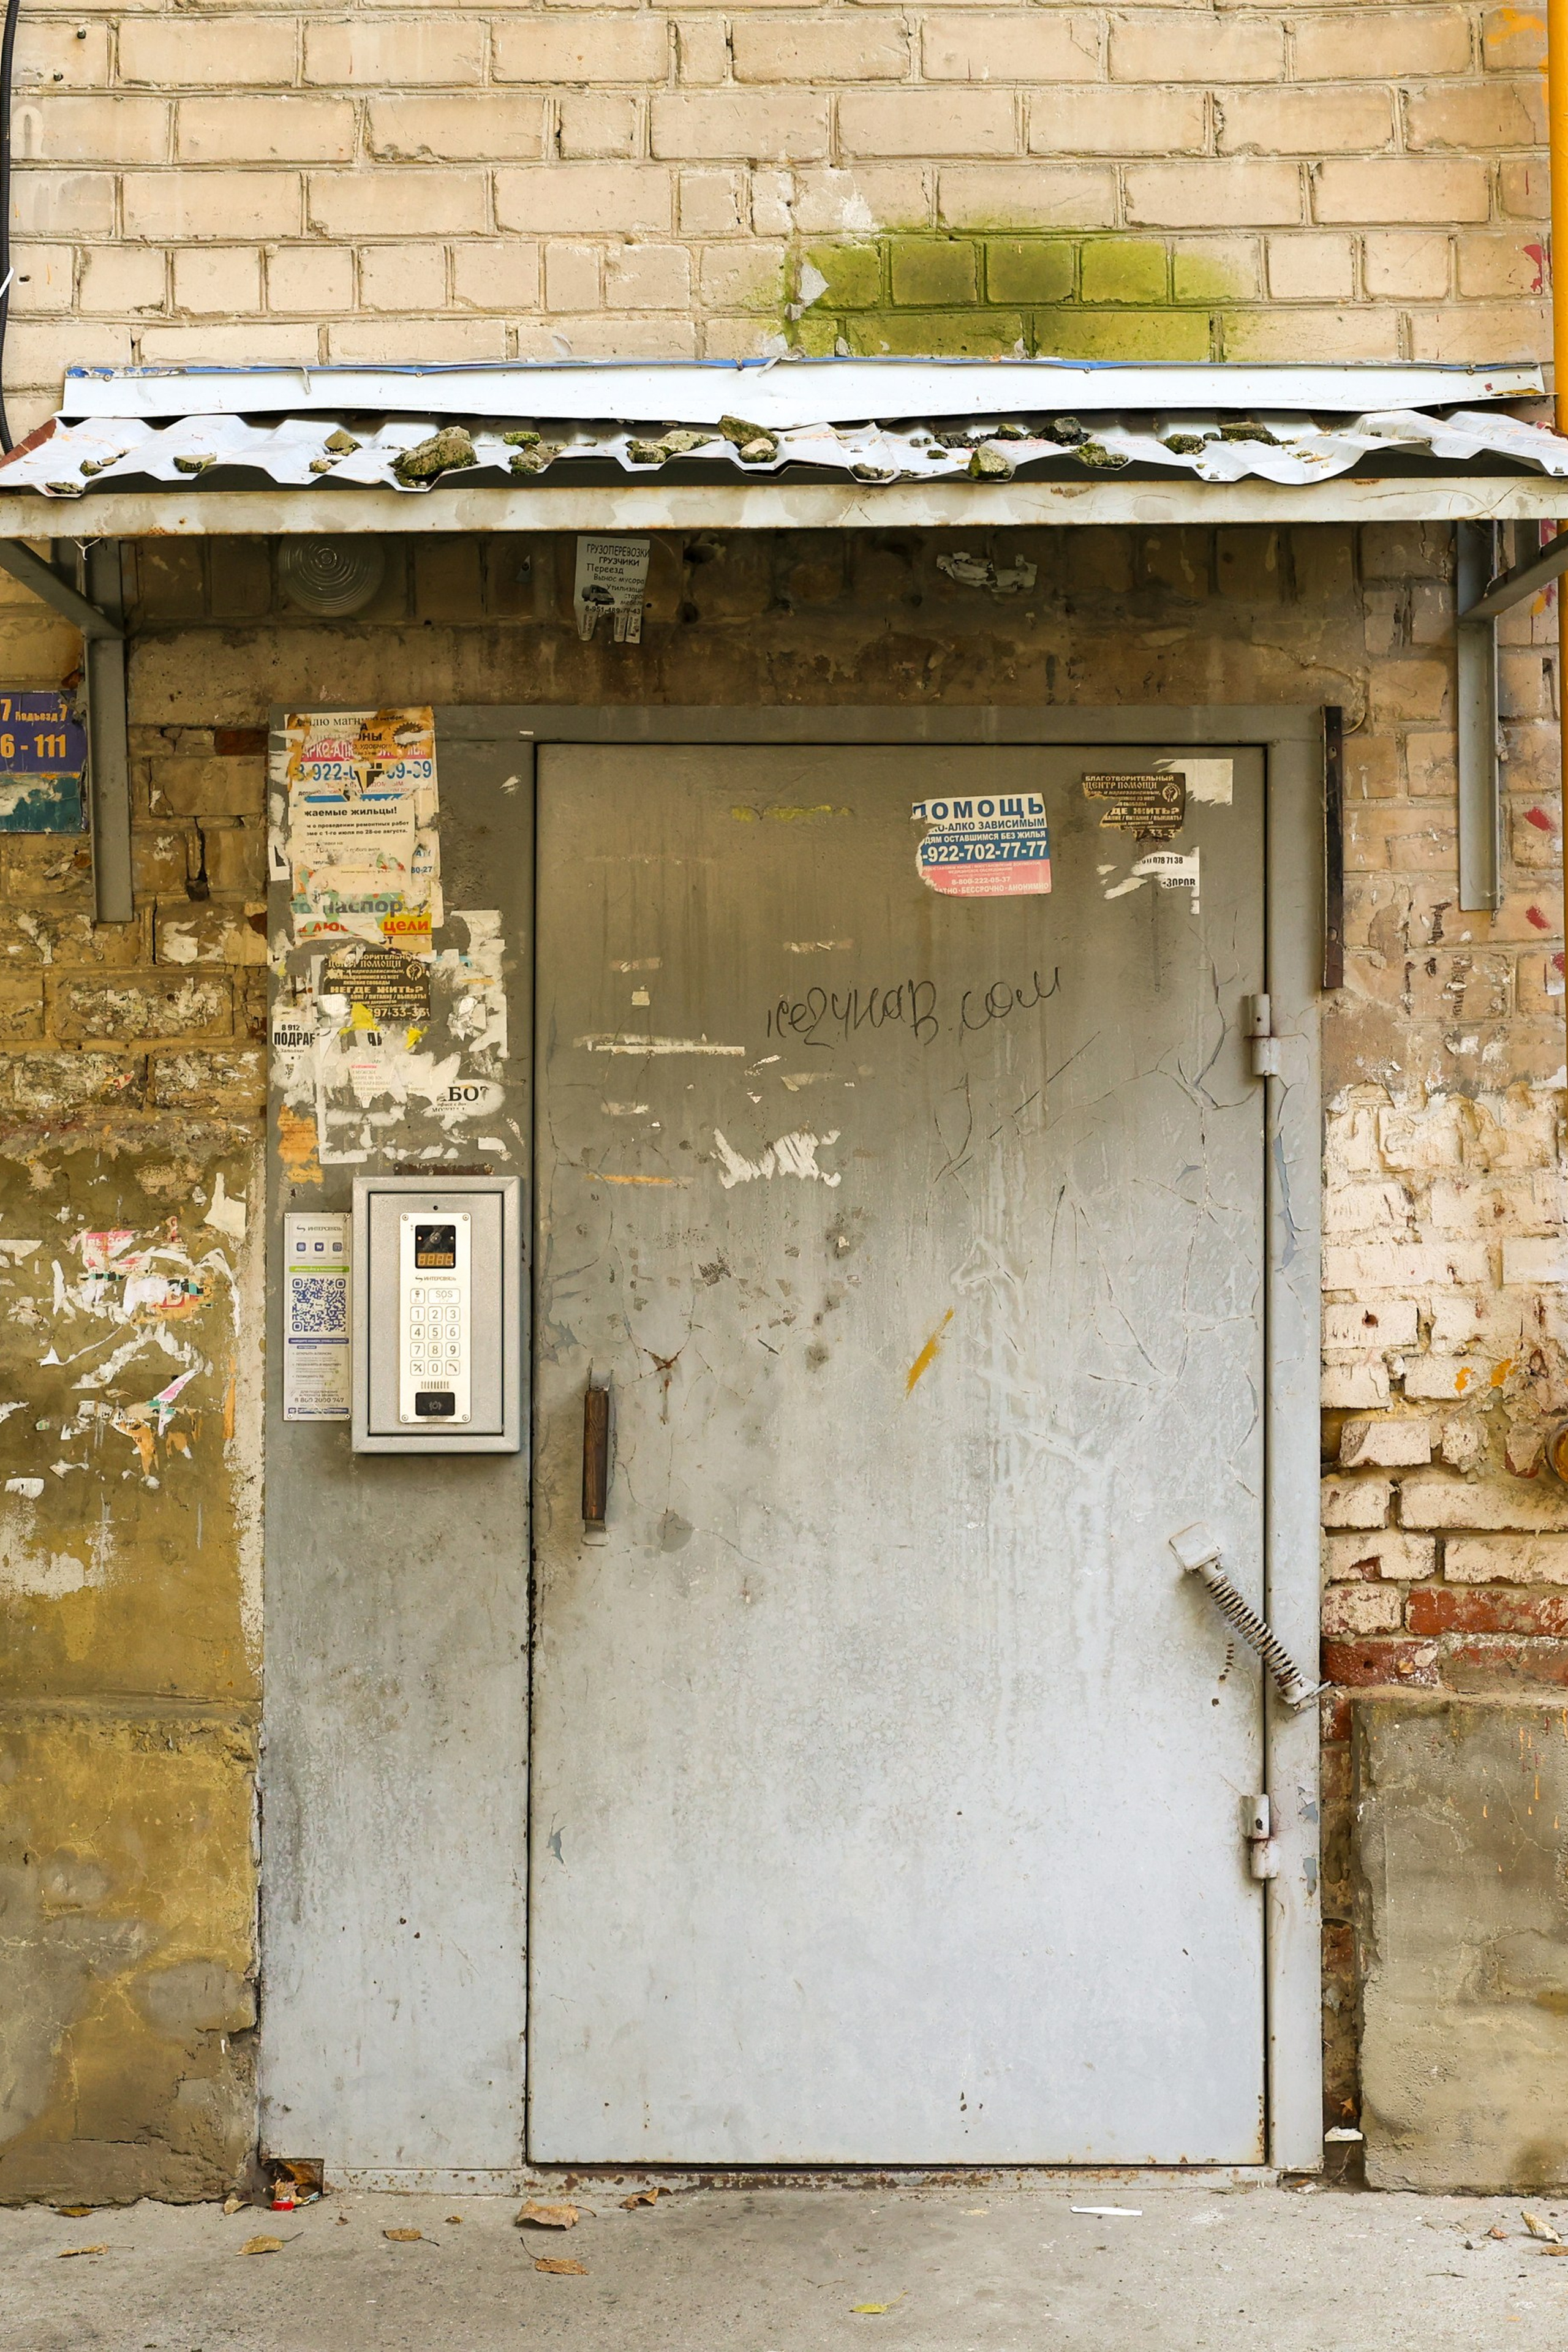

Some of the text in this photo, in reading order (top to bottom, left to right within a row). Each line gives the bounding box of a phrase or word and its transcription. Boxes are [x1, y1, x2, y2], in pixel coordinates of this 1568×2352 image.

[598, 557, 639, 566] ГРУЗЧИКИ
[587, 563, 624, 575] Переезд
[594, 573, 616, 582] Вынос
[15, 711, 58, 722] Подъезд
[59, 704, 67, 722] 7
[34, 734, 66, 758] 111
[1086, 782, 1156, 790] ЦЕНТР ПОМОЩИ
[351, 807, 397, 816] жильцы!
[913, 797, 1043, 820] ПОМОЩЬ
[978, 818, 1044, 829] ЗАВИСИМЫМ
[944, 833, 998, 843] ОСТАВШИМСЯ
[951, 876, 1011, 885] 8-800-222-05-37
[383, 921, 428, 933] цели
[360, 960, 401, 968] ПОМОЩИ
[415, 1310, 456, 1319] 1 2 3
[414, 1327, 456, 1336] 4 5 6
[414, 1345, 456, 1354] 7 8 9
[432, 1363, 439, 1373] 0
